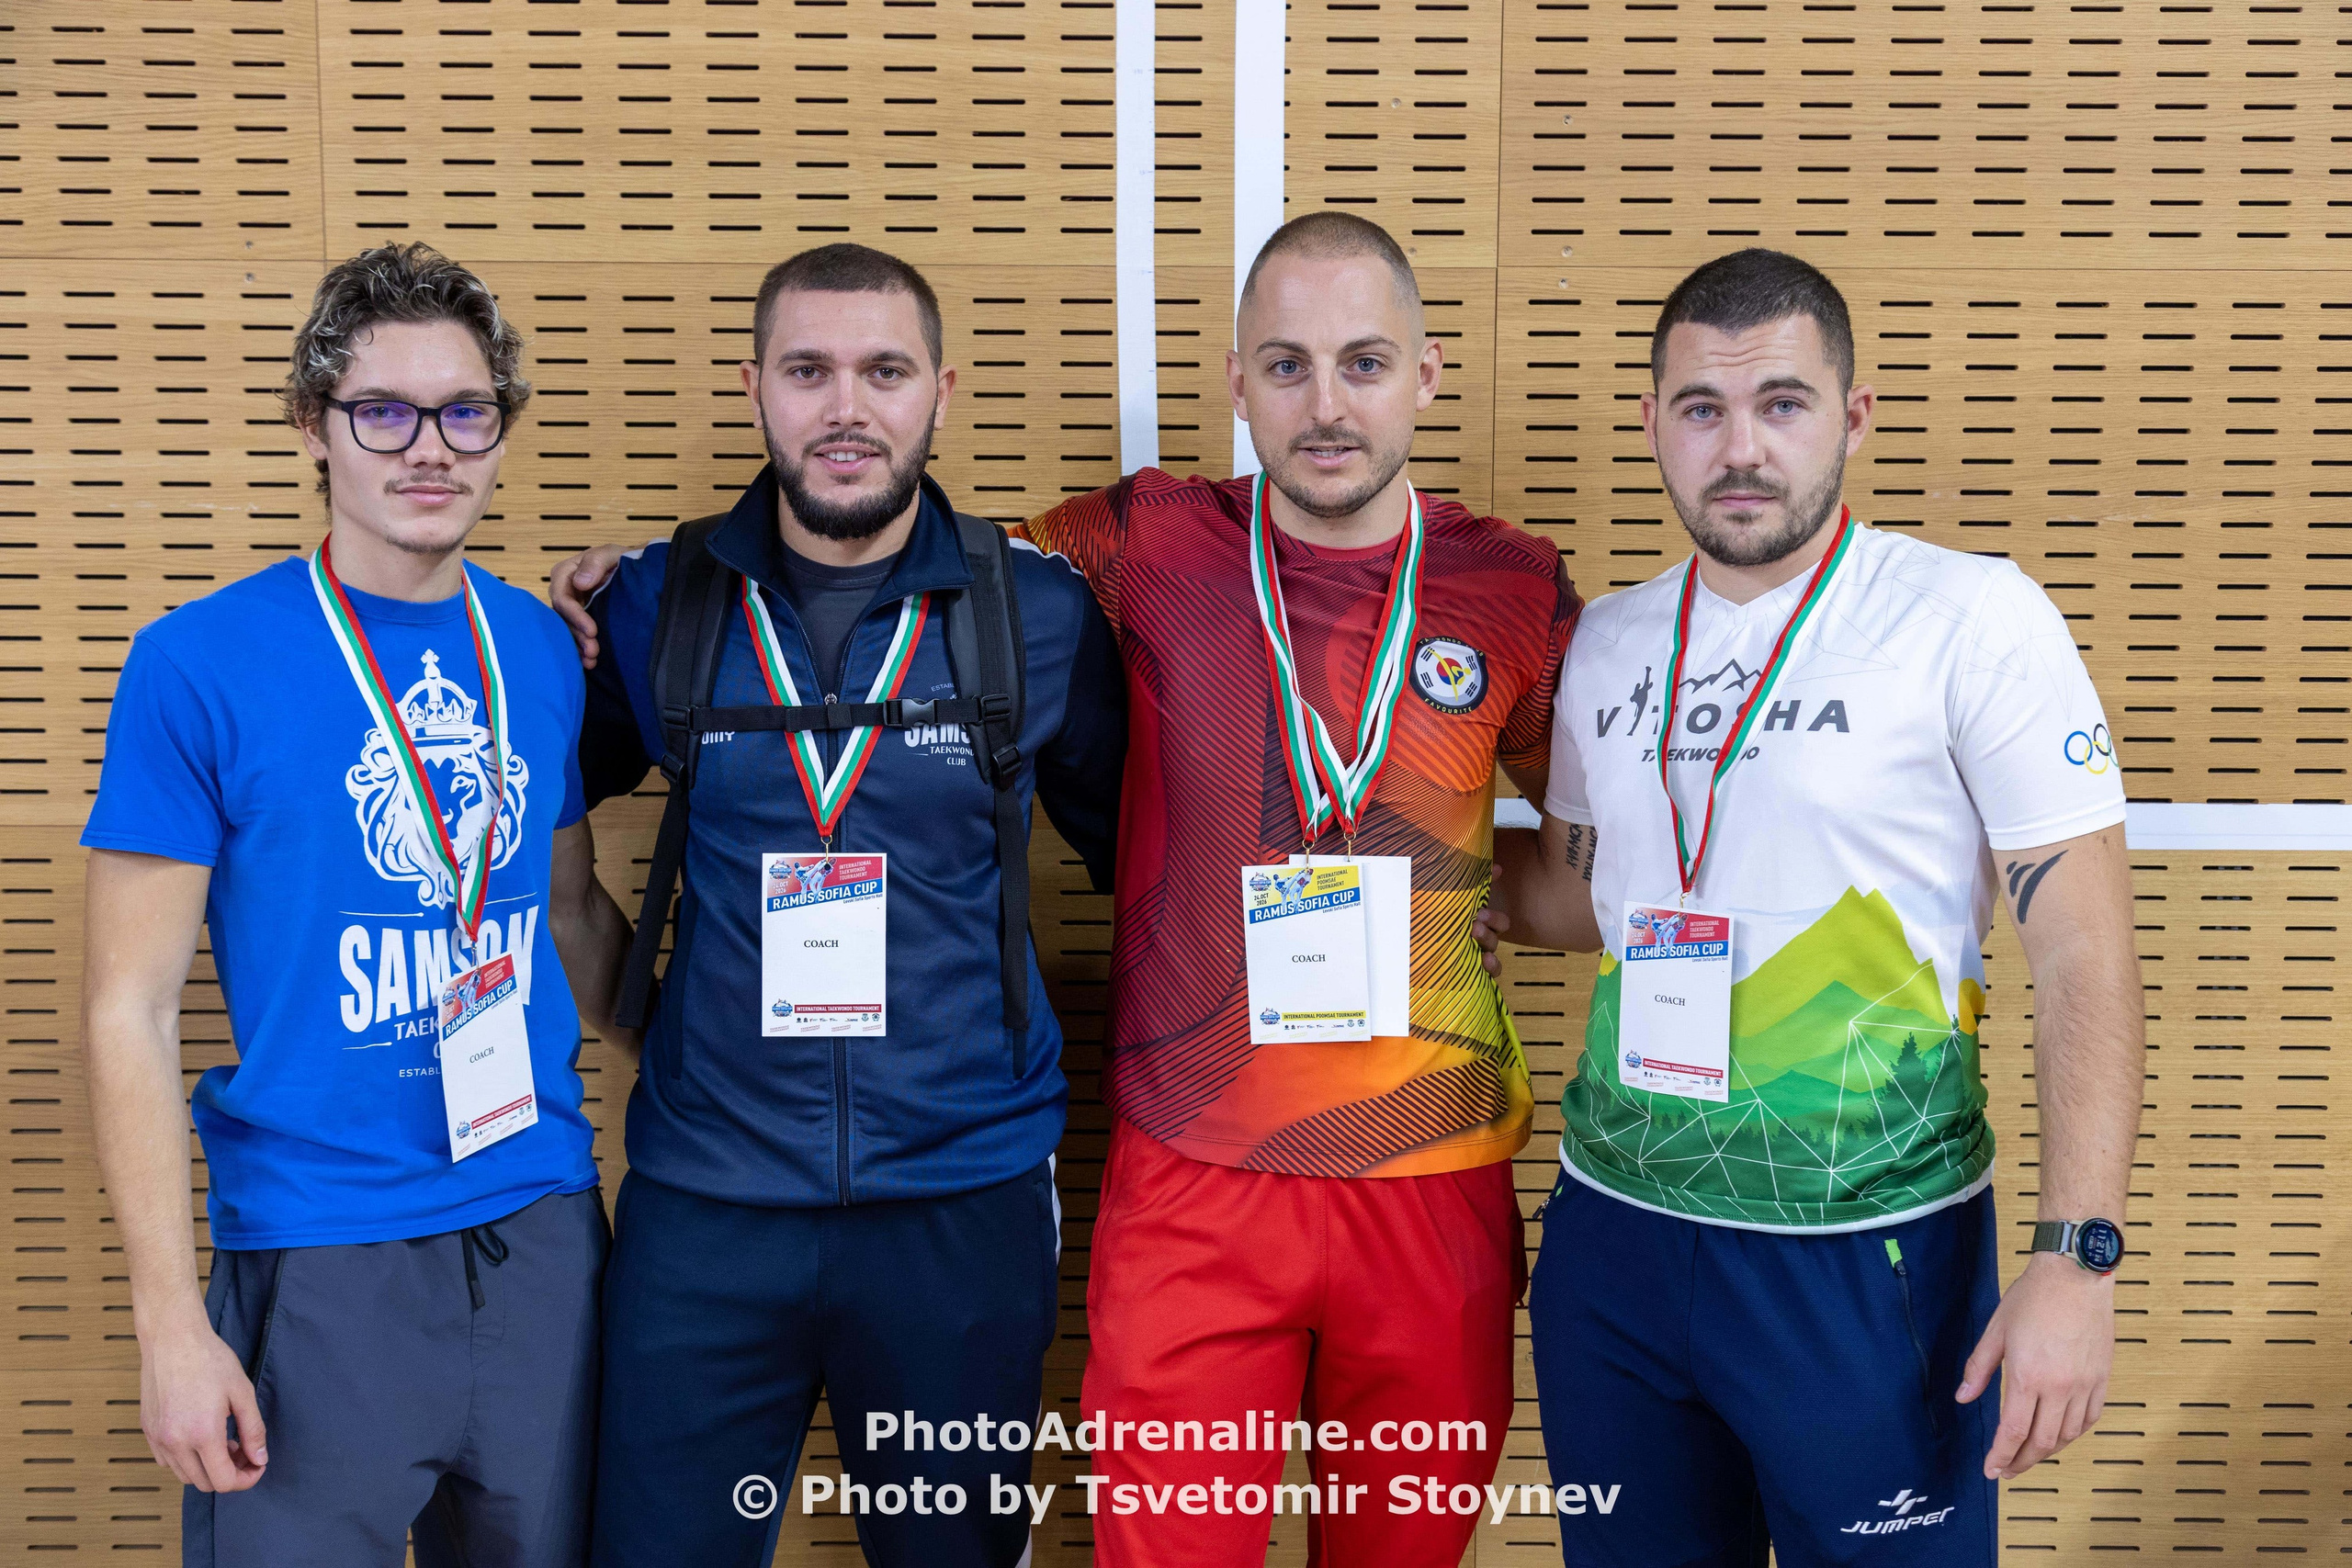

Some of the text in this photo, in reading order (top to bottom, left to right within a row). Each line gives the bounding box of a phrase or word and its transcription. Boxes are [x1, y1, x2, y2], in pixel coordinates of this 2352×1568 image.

[1424, 697, 1473, 714] FAVOURITE
[1640, 746, 1760, 762] TEKWOO
[946, 756, 967, 766] CLUB
[839, 860, 872, 870] INTERNATIONAL
[839, 866, 866, 875] TAEKWONDO
[839, 872, 868, 881] TOURNAMENT
[1317, 869, 1349, 880] INTERNATIONAL
[1317, 876, 1336, 886] POOMSAE
[1317, 881, 1345, 891] TOURNAMENT
[773, 881, 877, 909] RAMUS SOFIA CUP
[1255, 890, 1355, 921] RAMUS SOFIA CUP
[803, 939, 839, 948] COACH
[1631, 943, 1724, 959] RAMUS SOFIA CUP
[1291, 953, 1326, 963] COACH
[1654, 994, 1686, 1006] COACH
[446, 1008, 472, 1037] RAMUS
[473, 991, 496, 1014] SOFIA
[496, 979, 513, 998] CUP
[469, 1045, 495, 1064] COACH
[1840, 1506, 1954, 1534] JUMPER
